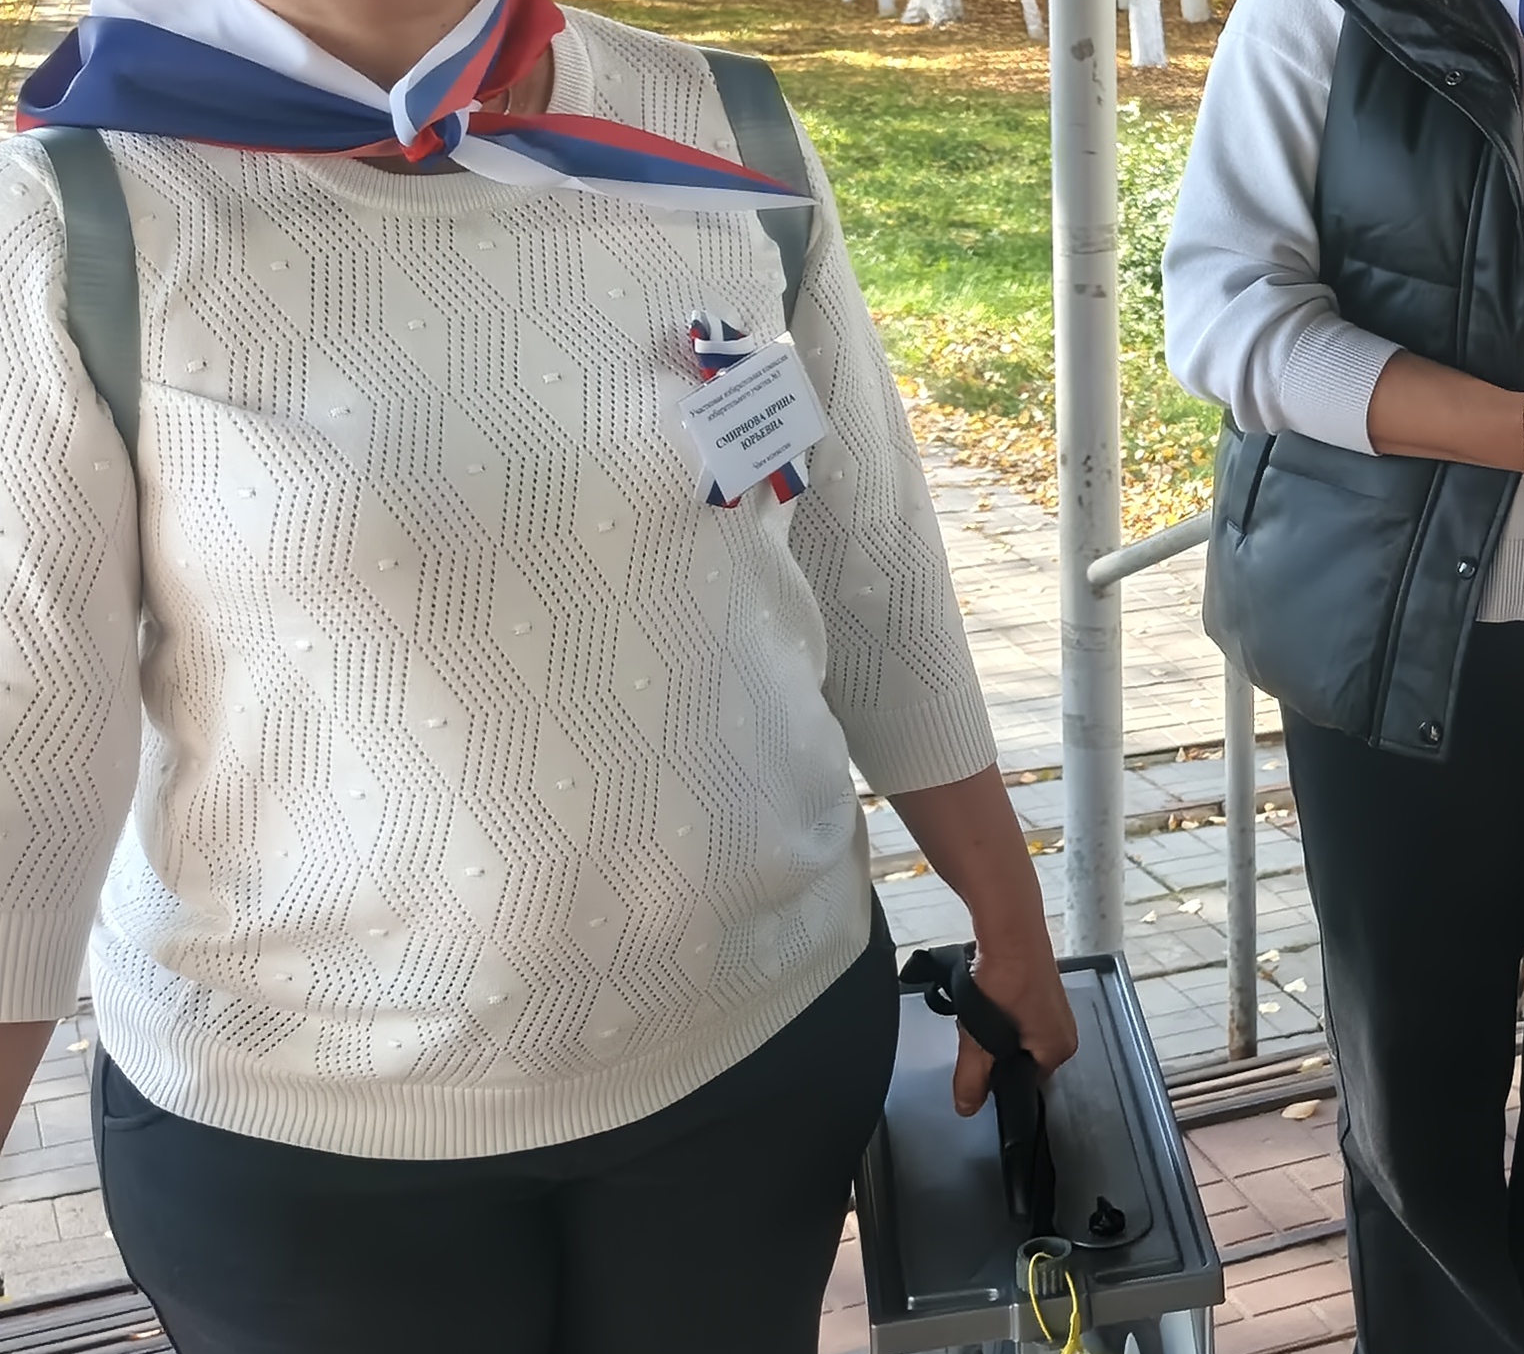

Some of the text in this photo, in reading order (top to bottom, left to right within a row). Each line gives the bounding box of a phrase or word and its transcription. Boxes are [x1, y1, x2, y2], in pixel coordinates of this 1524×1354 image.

[715, 393, 796, 449] СМИРНОВА ИРИНА
[740, 417, 784, 451] ЮРЬЕВНА
